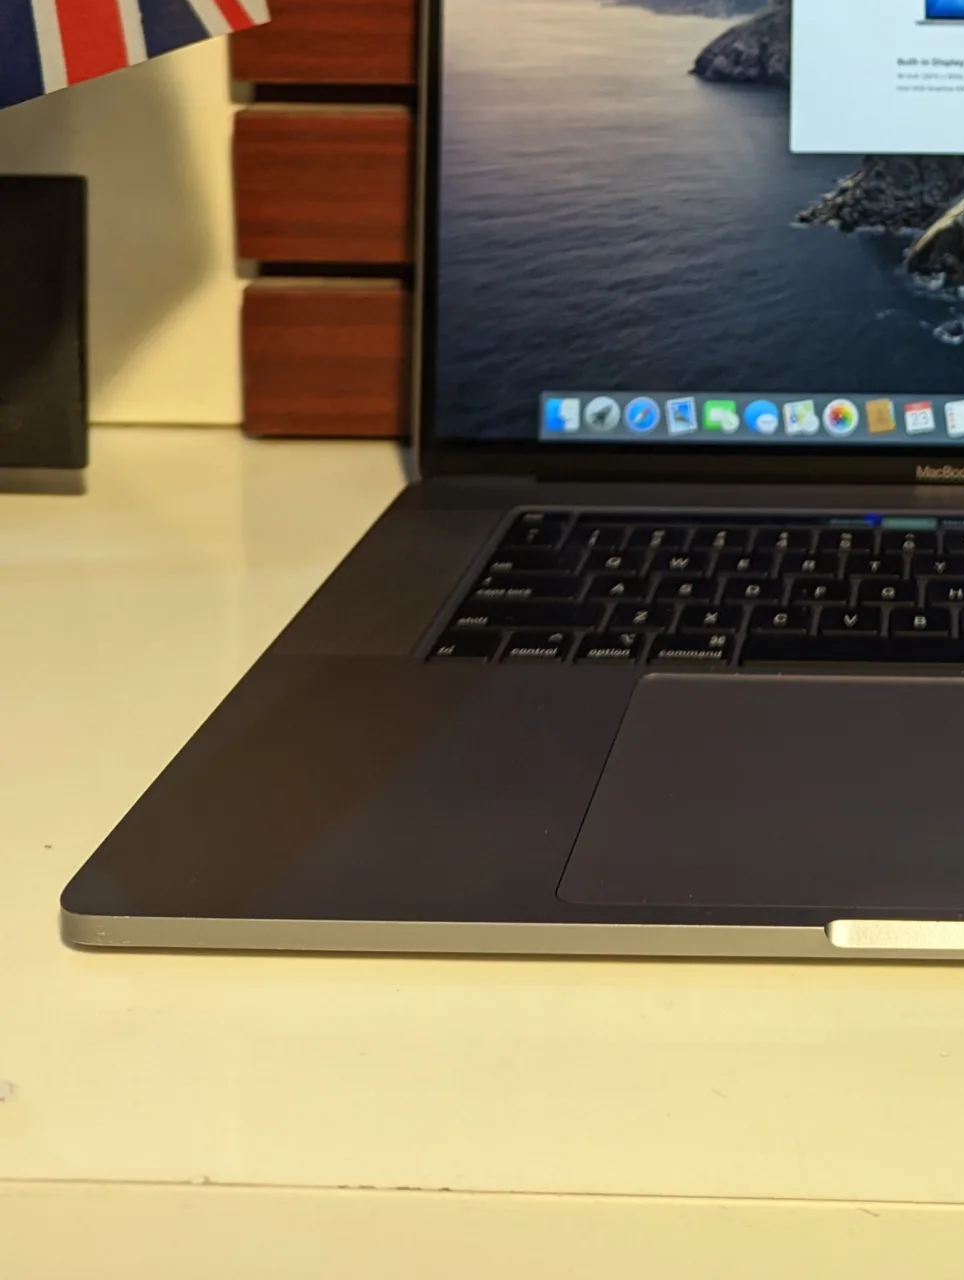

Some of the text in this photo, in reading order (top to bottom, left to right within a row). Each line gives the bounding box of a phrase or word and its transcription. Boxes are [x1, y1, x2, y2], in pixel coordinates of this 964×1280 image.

[510, 646, 559, 657] control
[586, 646, 631, 659] option
[658, 647, 723, 658] command
